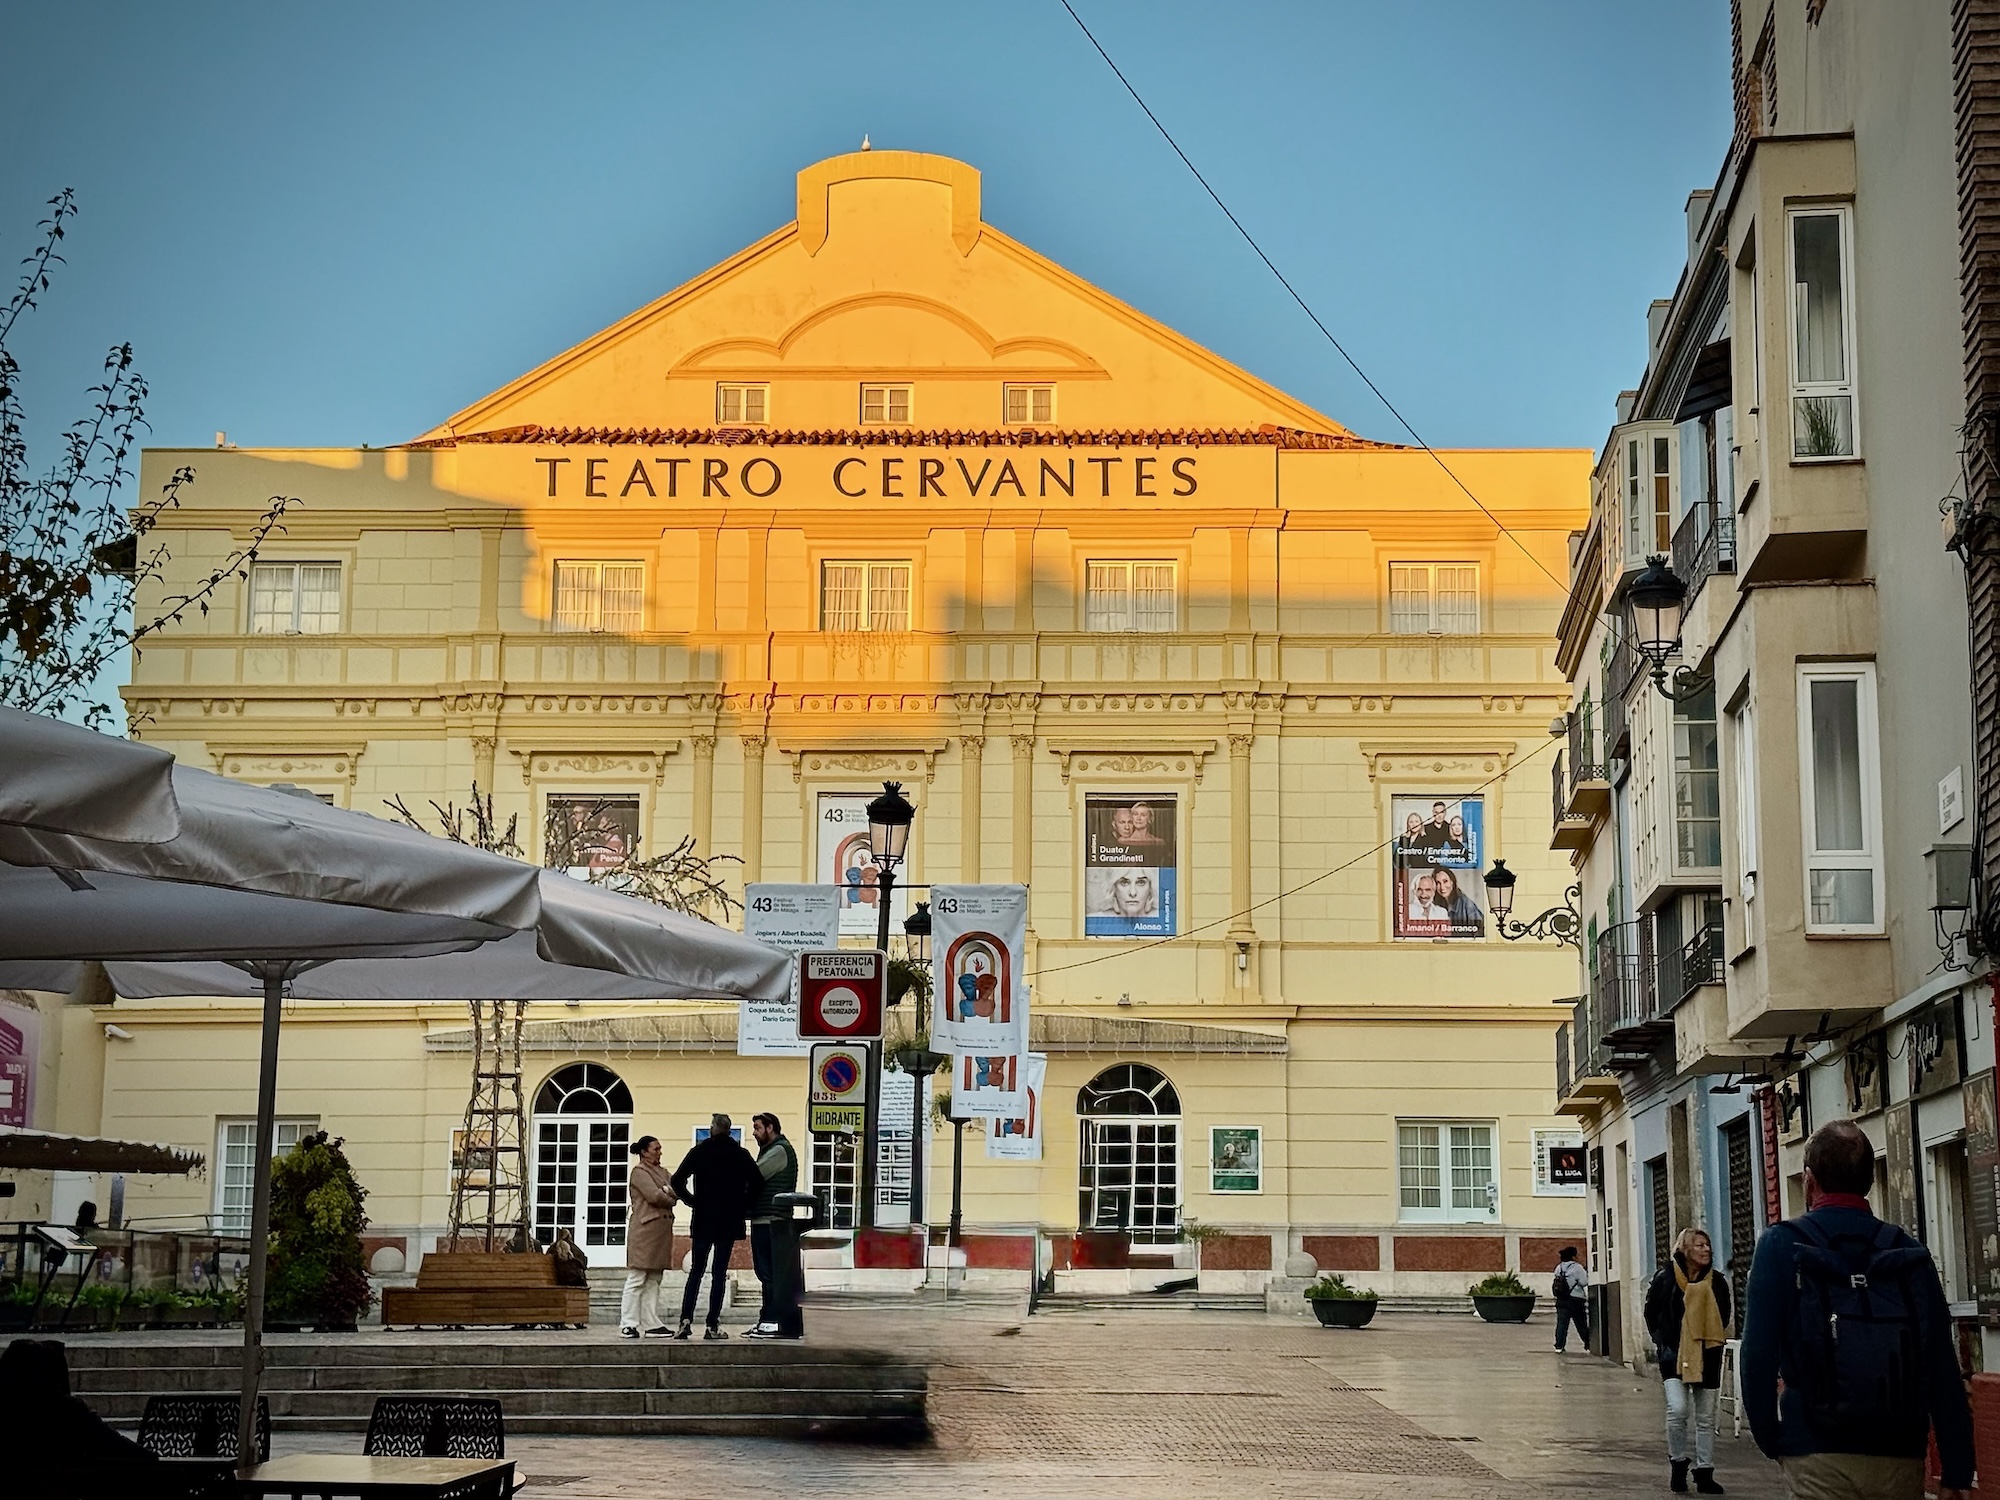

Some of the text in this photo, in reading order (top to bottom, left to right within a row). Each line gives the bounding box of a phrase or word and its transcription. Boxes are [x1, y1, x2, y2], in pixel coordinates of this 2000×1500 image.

[535, 457, 1198, 497] TEATRO CERVANTES
[824, 808, 844, 822] 43
[1100, 846, 1124, 854] Duato
[1396, 847, 1423, 855] Castro
[1099, 854, 1144, 862] Grandinetti
[1427, 856, 1466, 864] Cremonte
[752, 897, 772, 913] 43
[938, 898, 958, 913] 43
[1134, 922, 1162, 931] Alonso
[1406, 923, 1434, 932] Imanol
[1441, 924, 1478, 932] Barranco
[810, 956, 874, 966] PREFERENCIA
[818, 967, 866, 977] PEATONAL
[815, 1111, 861, 1126] HIDRANTE
